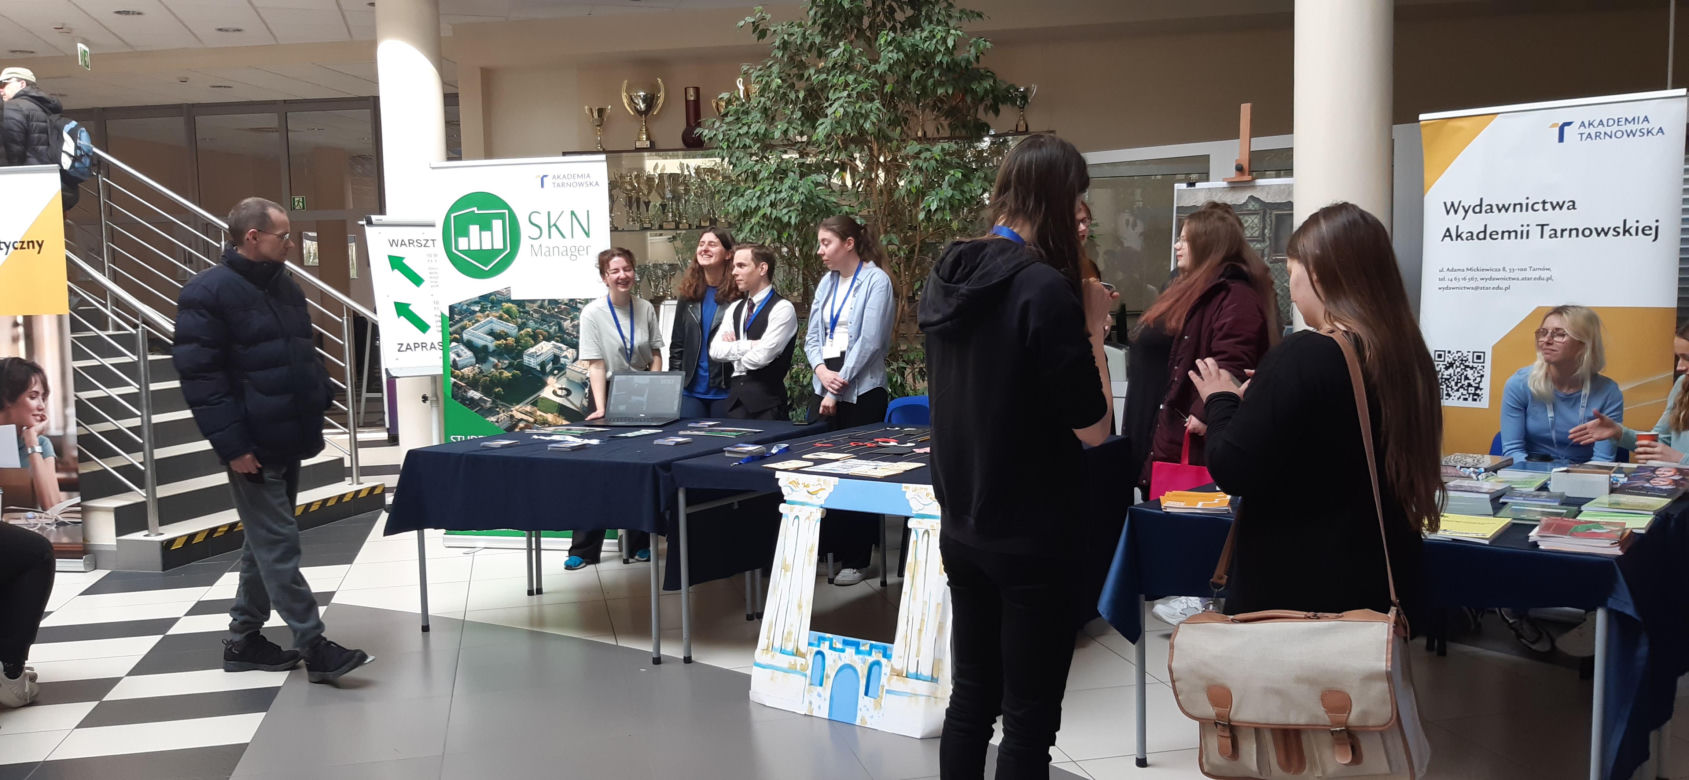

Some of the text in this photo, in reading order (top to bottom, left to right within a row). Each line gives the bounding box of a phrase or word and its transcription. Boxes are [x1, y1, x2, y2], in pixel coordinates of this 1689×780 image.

[1578, 115, 1650, 129] AKADEMIA
[1578, 126, 1665, 141] TARNOWSKA
[1443, 197, 1577, 220] Wydawnictwa
[528, 209, 590, 240] SKN
[1441, 218, 1660, 242] Akademii Tarnowskiej
[530, 243, 591, 261] Manager
[1466, 265, 1501, 273] Mickiewicza
